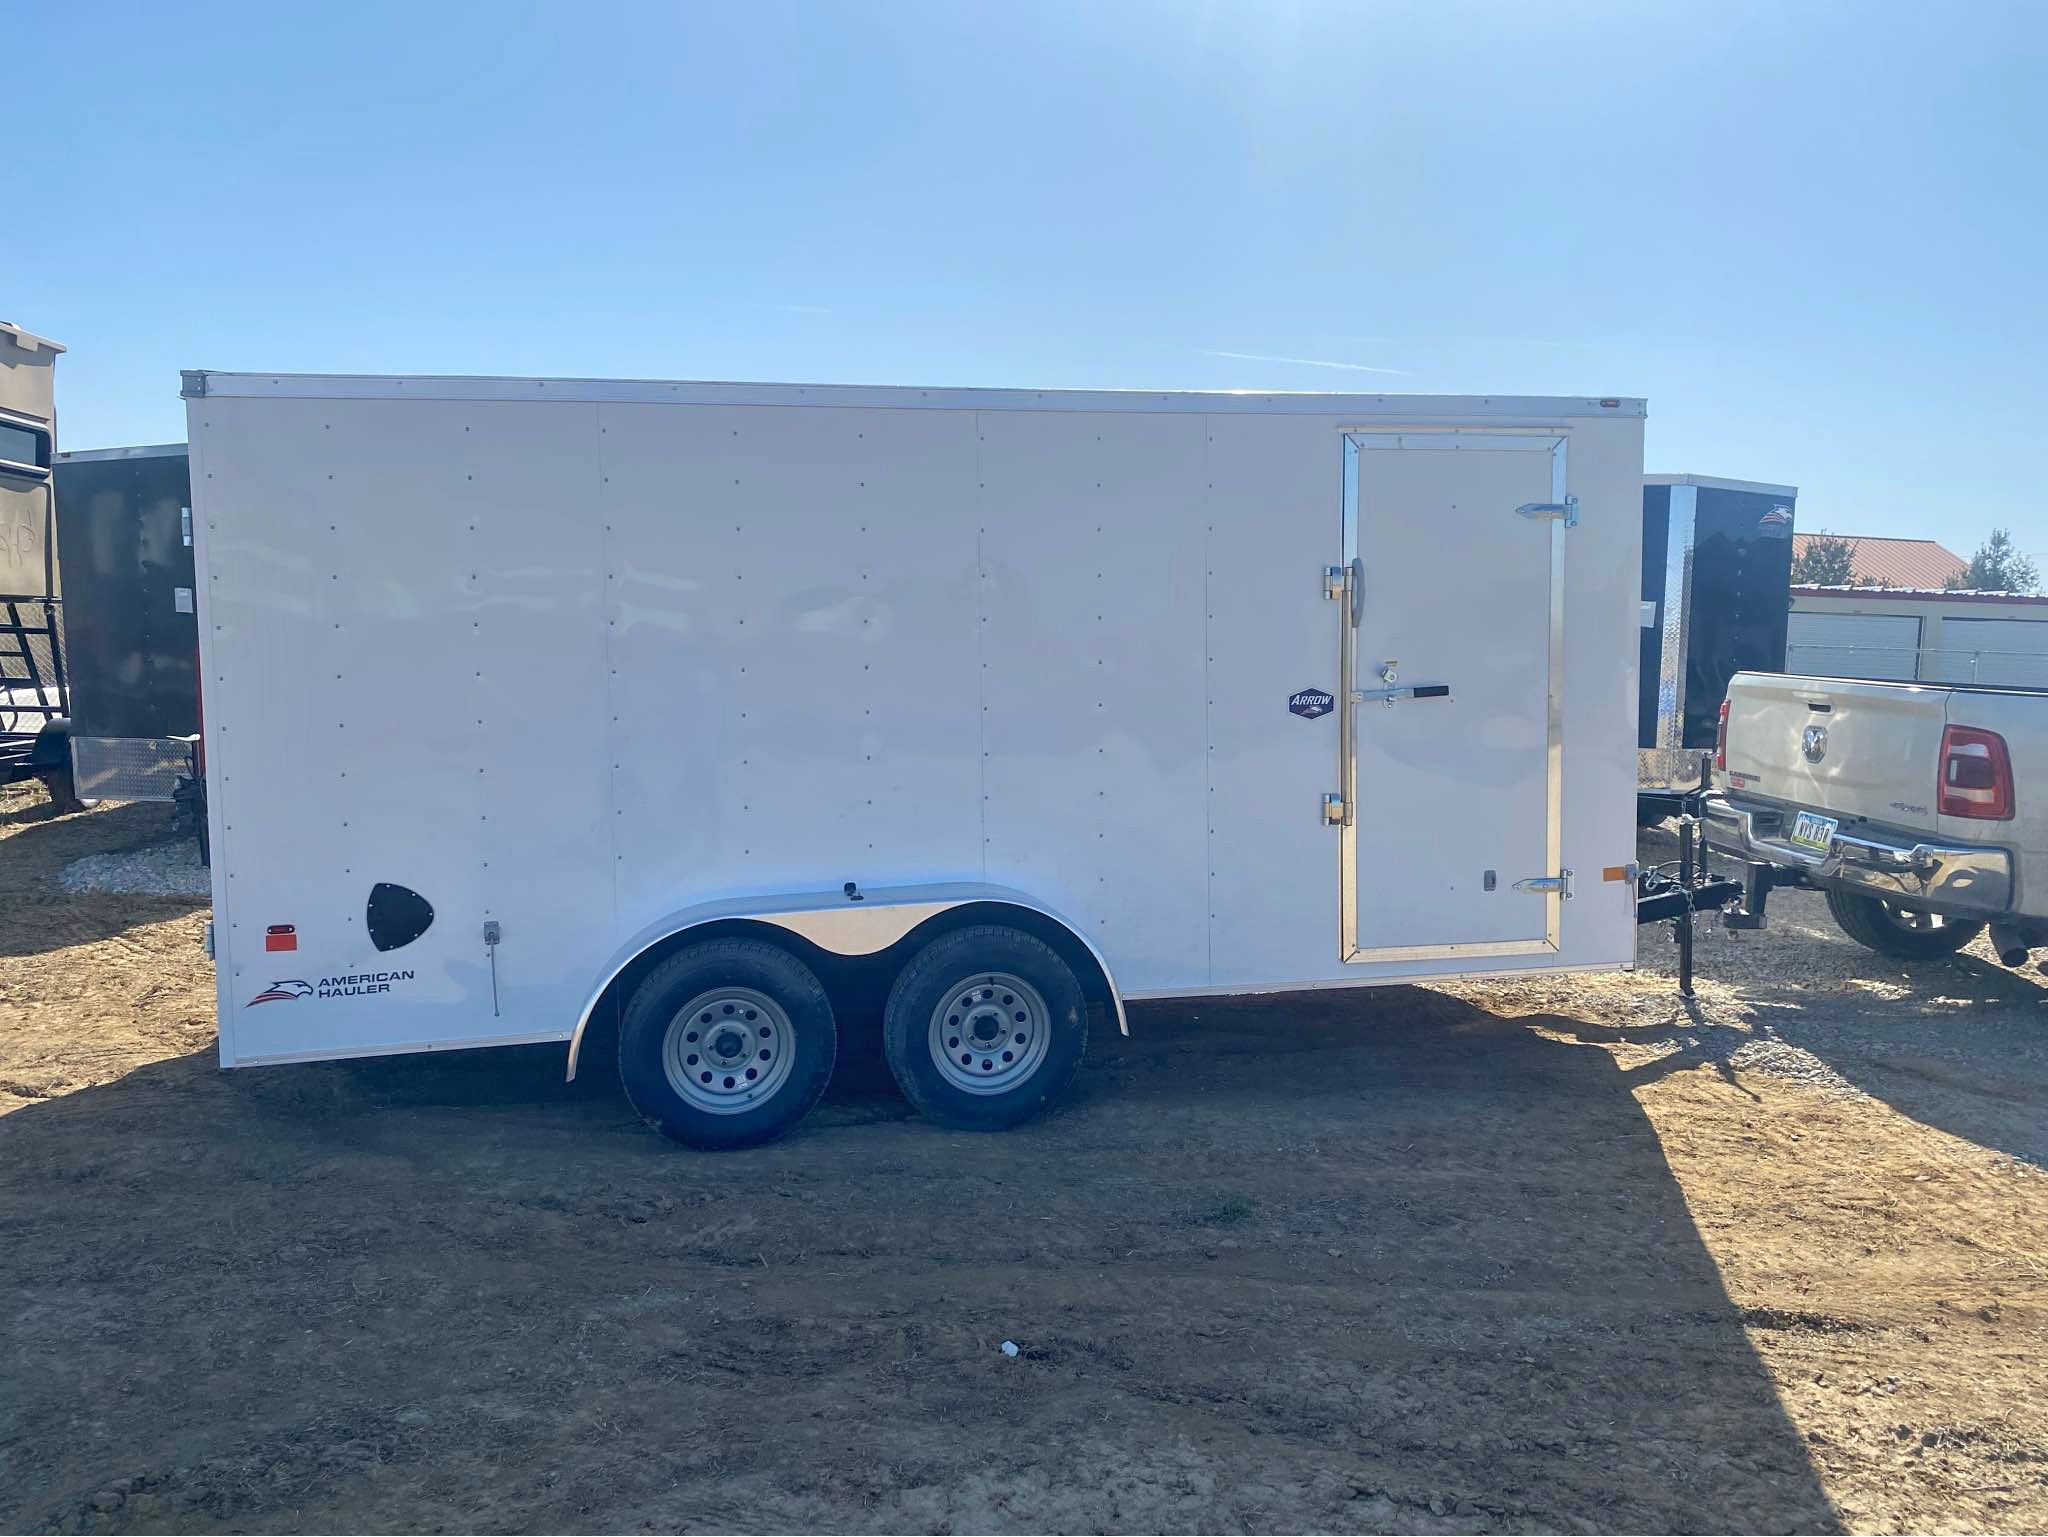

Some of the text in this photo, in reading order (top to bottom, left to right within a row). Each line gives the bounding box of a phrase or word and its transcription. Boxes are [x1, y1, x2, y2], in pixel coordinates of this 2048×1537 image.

[1291, 694, 1332, 706] ARROW
[318, 970, 415, 988] AMERICAN
[318, 983, 391, 999] HAULER
